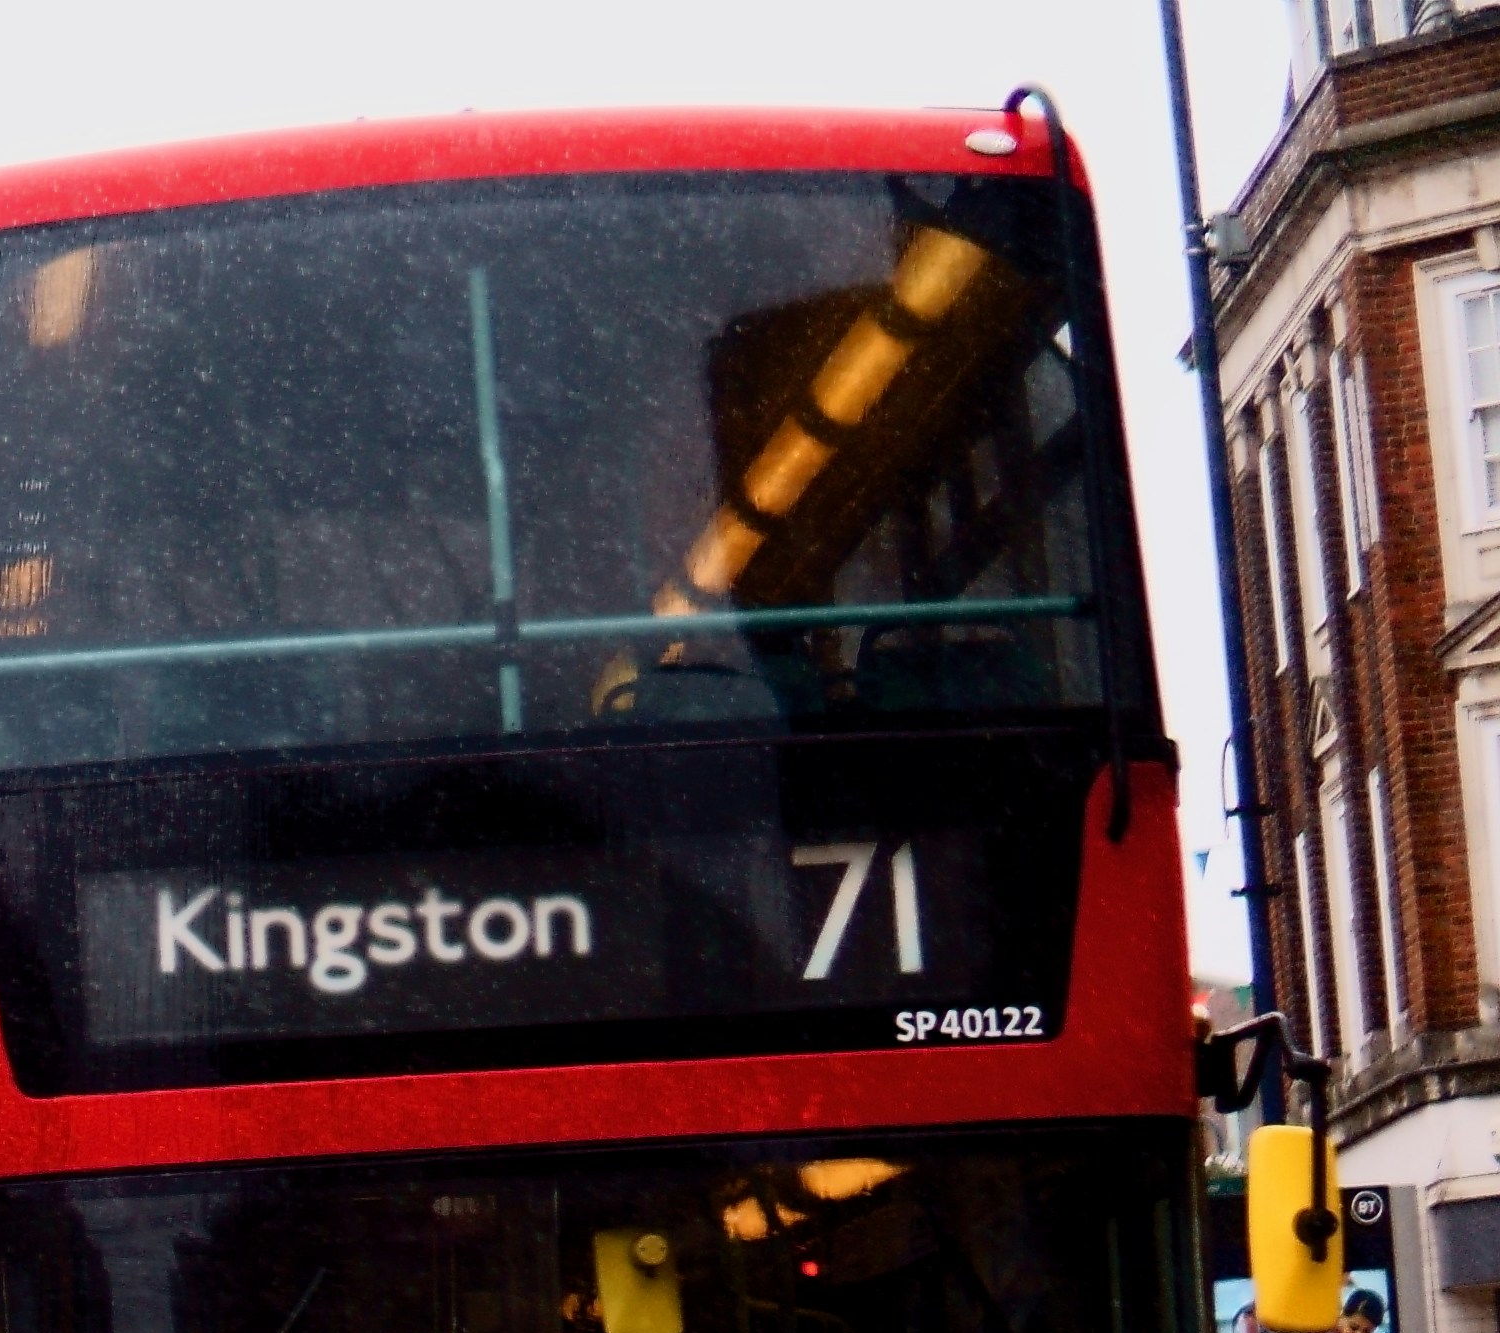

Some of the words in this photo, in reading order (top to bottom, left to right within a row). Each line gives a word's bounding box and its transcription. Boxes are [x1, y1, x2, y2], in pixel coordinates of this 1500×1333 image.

[156, 886, 592, 992] Kingston
[790, 841, 924, 981] 71
[1357, 1200, 1376, 1214] BT
